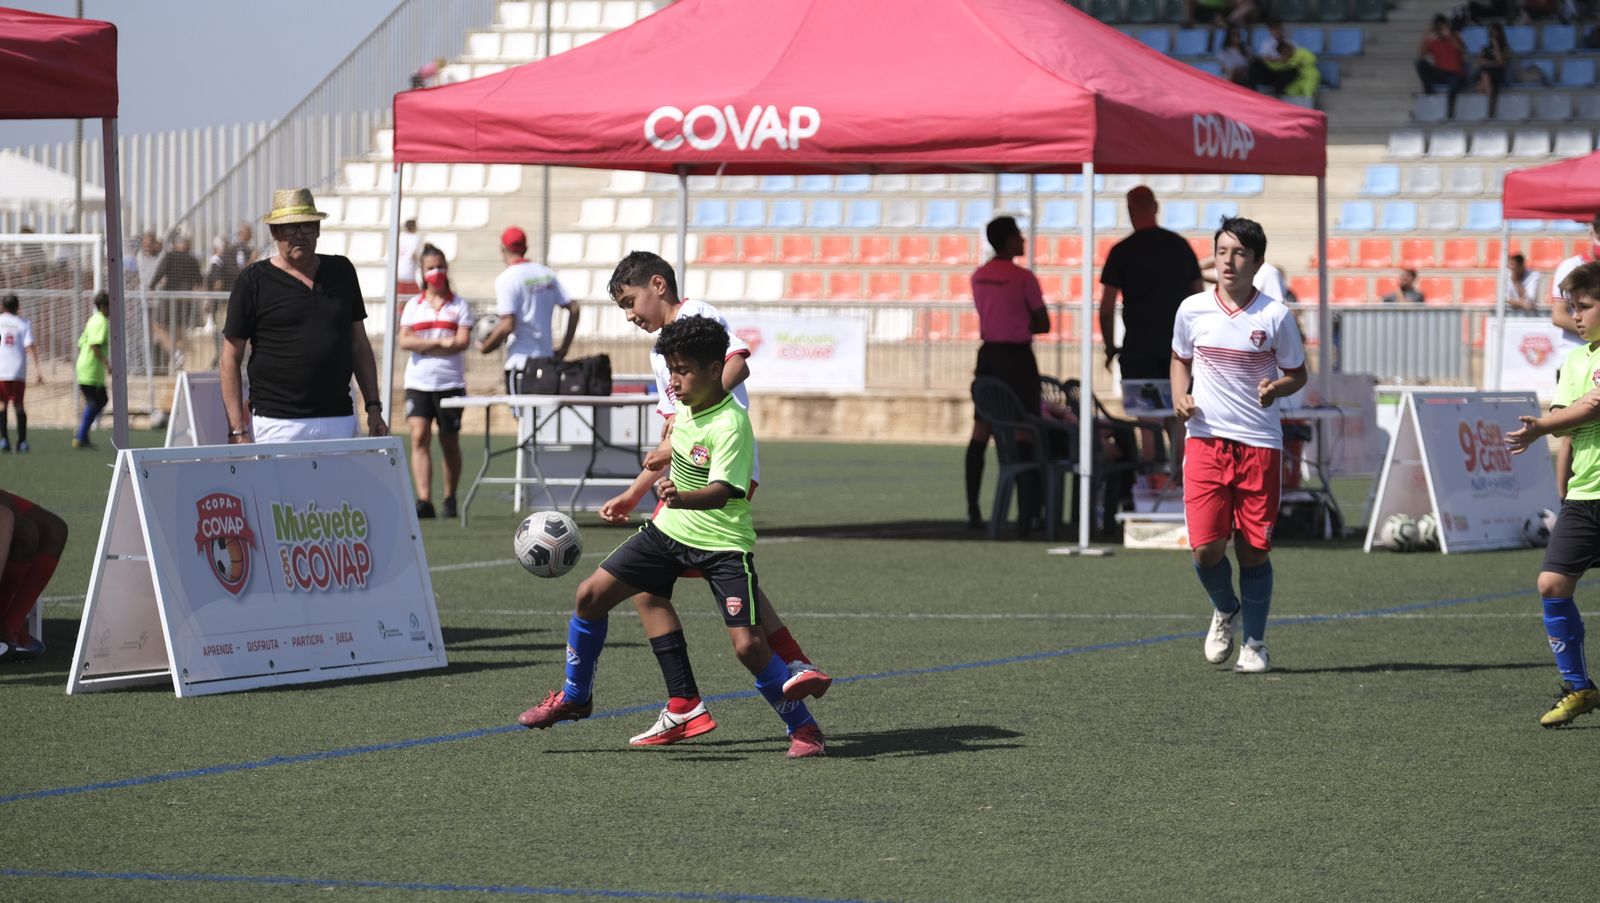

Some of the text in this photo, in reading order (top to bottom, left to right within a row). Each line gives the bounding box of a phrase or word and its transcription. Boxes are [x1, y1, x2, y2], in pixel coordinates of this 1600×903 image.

[644, 105, 821, 151] COVAP
[1192, 112, 1256, 160] COVAP
[202, 515, 244, 538] COVAP
[271, 502, 366, 541] Muévete
[292, 542, 371, 590] COVAP
[203, 631, 354, 657] APRENDE DISFRUTA PARTICIPA JUEGA
